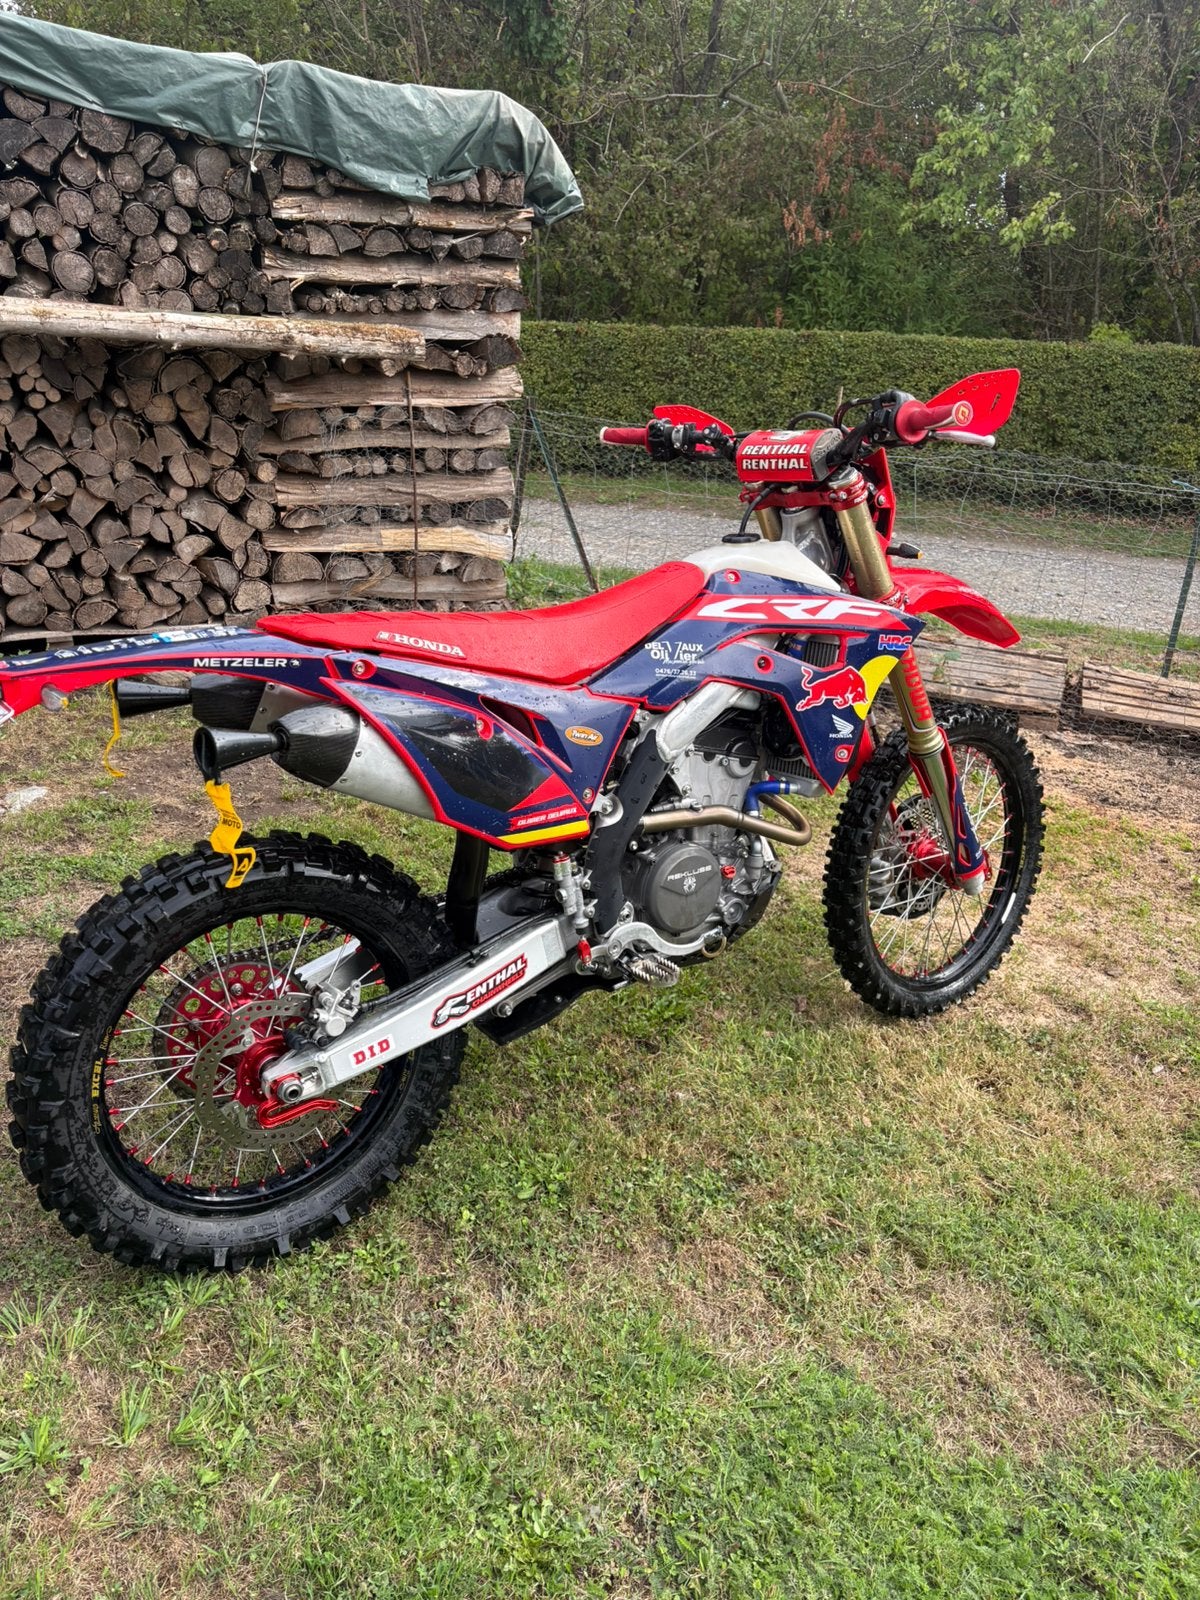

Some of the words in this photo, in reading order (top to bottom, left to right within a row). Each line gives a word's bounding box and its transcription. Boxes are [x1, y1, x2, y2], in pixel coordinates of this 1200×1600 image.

[742, 444, 807, 455] RENTHAL
[742, 458, 808, 470] RENTHAL
[697, 598, 887, 620] CRF
[394, 633, 465, 657] HONDA
[878, 634, 913, 650] HRC
[193, 657, 288, 668] METZELER
[222, 817, 241, 829] MOTO
[91, 1057, 103, 1098] EXCEL
